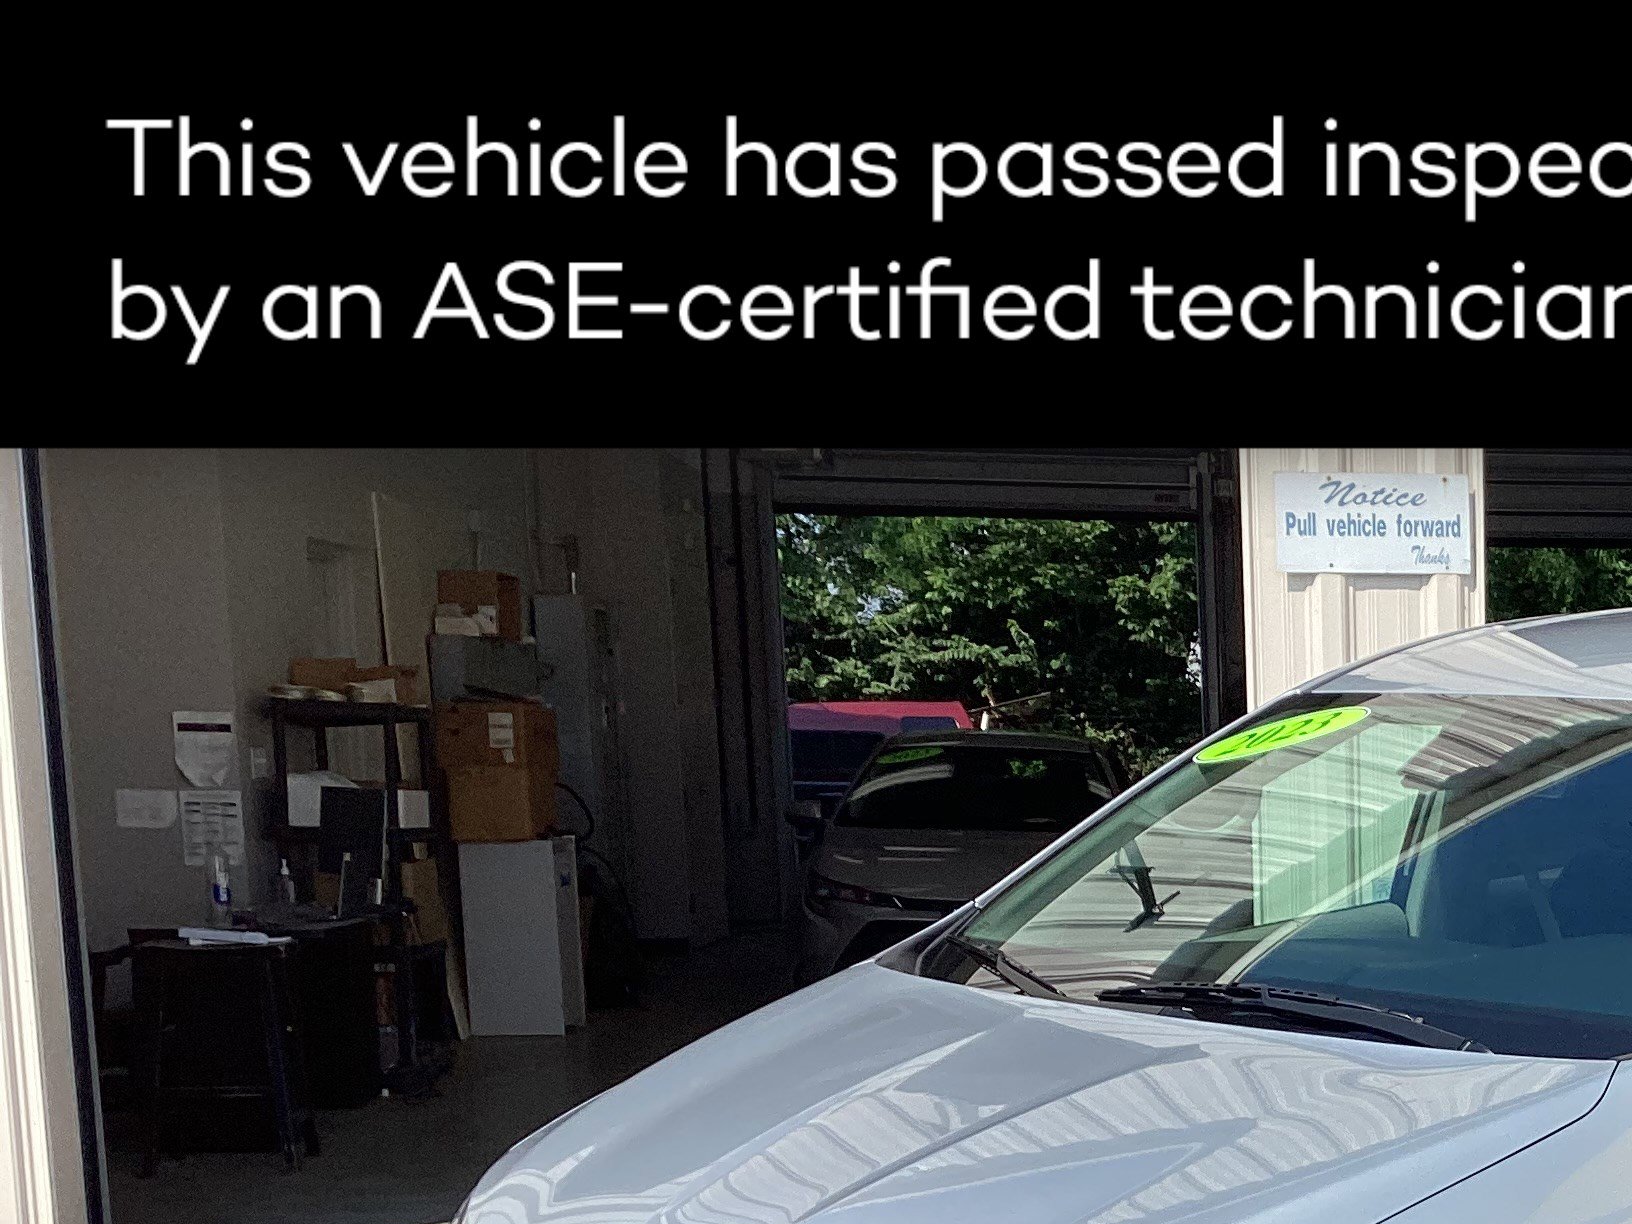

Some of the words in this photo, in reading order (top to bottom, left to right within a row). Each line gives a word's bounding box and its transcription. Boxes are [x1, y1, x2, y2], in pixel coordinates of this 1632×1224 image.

[1319, 480, 1427, 507] Notice
[1285, 511, 1317, 536] Pull
[1326, 512, 1387, 537] vehicle
[1397, 513, 1461, 538] forward
[1411, 545, 1450, 565] Thanks
